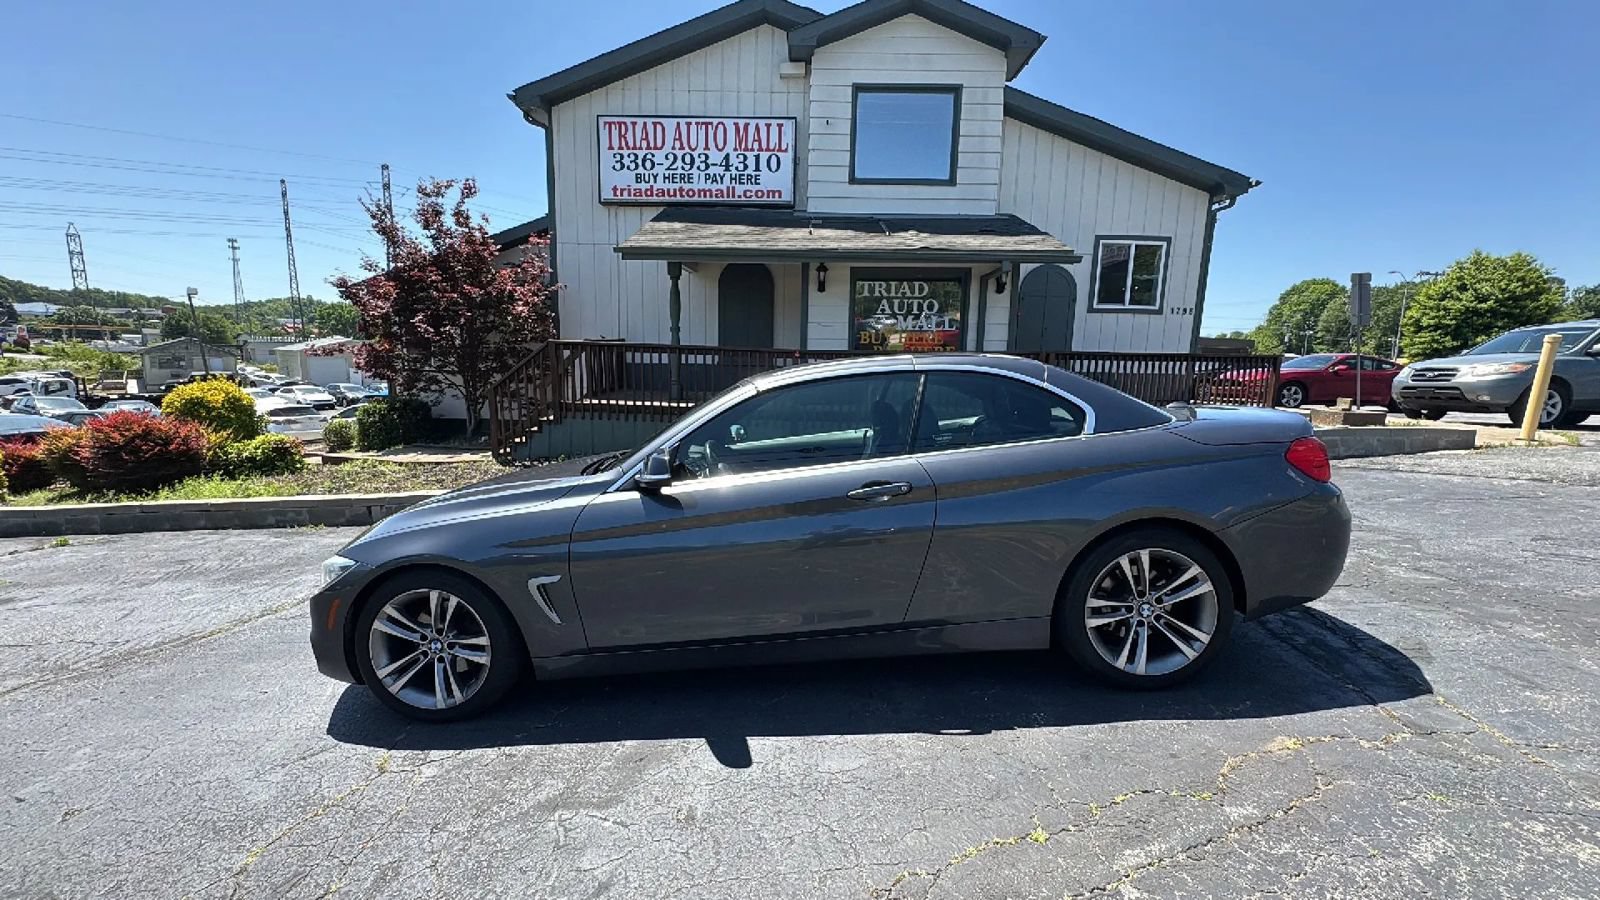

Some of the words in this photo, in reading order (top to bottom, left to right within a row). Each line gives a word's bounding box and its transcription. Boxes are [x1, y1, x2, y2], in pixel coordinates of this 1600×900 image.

[603, 121, 667, 151] TRIAD
[672, 121, 728, 152] AUTO
[733, 122, 789, 153] MALL
[611, 152, 782, 173] 336-293-4310
[634, 173, 659, 184] BUY
[663, 173, 694, 184] HERE
[697, 173, 701, 185] /
[704, 173, 726, 185] PAY
[729, 174, 761, 185] HERE
[611, 185, 783, 199] triadautomall.com
[857, 281, 929, 297] TRIAD
[876, 299, 939, 314] AUTO
[896, 315, 956, 331] MALL
